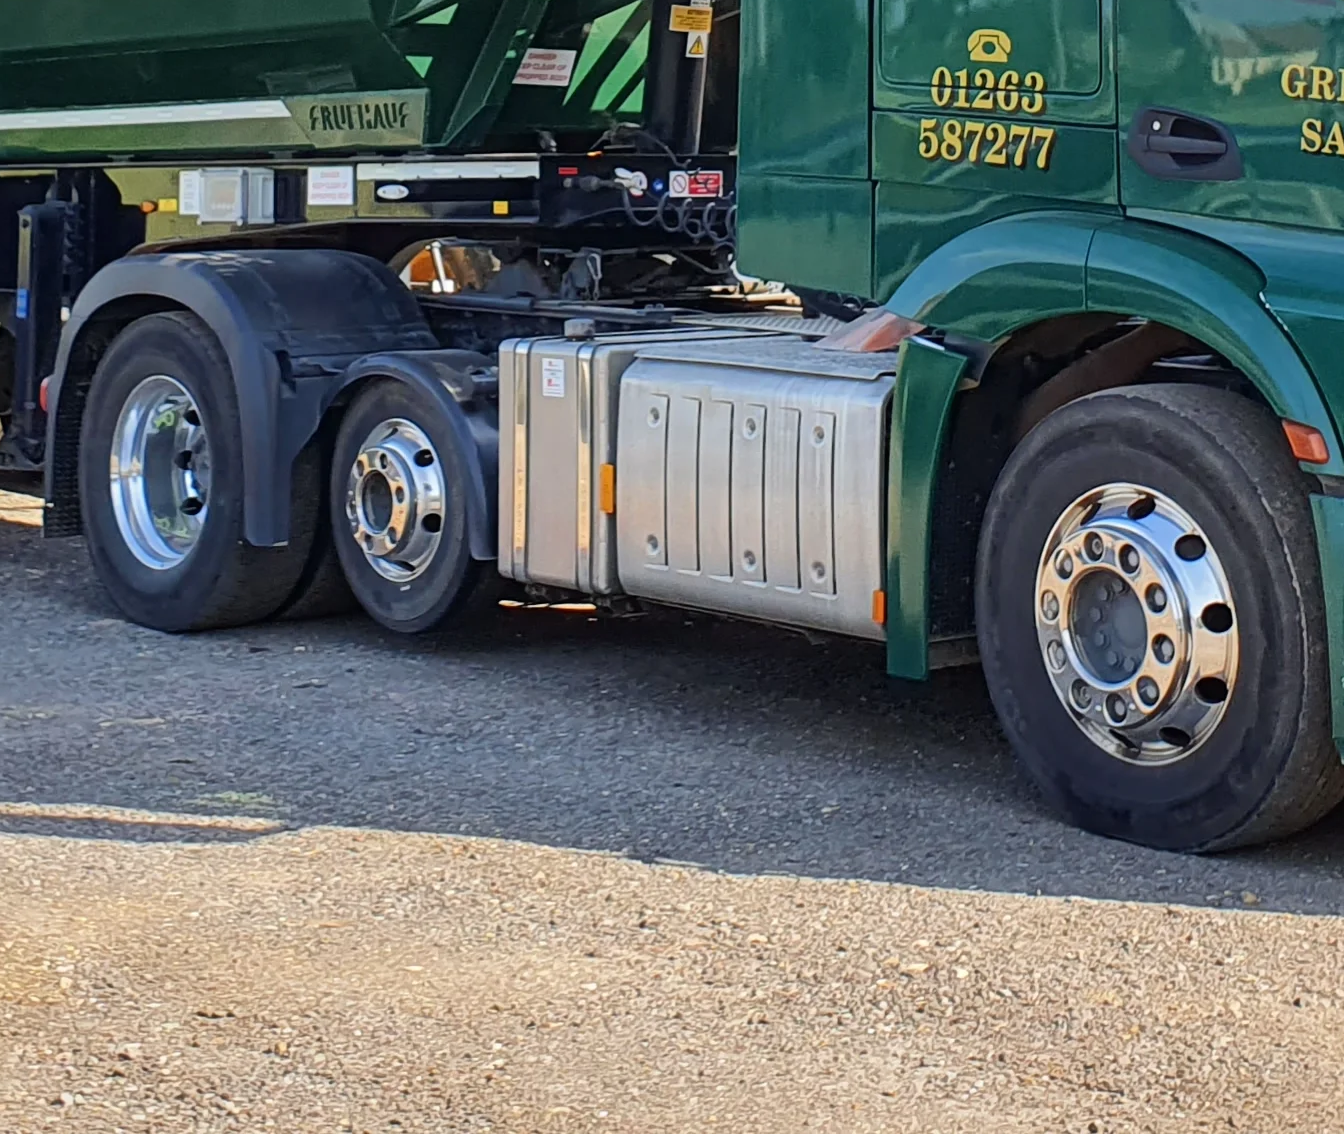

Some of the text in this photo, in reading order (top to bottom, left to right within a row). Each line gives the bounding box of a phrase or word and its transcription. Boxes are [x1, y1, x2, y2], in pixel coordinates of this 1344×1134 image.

[931, 66, 1044, 113] 01263
[309, 101, 408, 131] FRUEHAUF
[918, 118, 1054, 168] 587277
